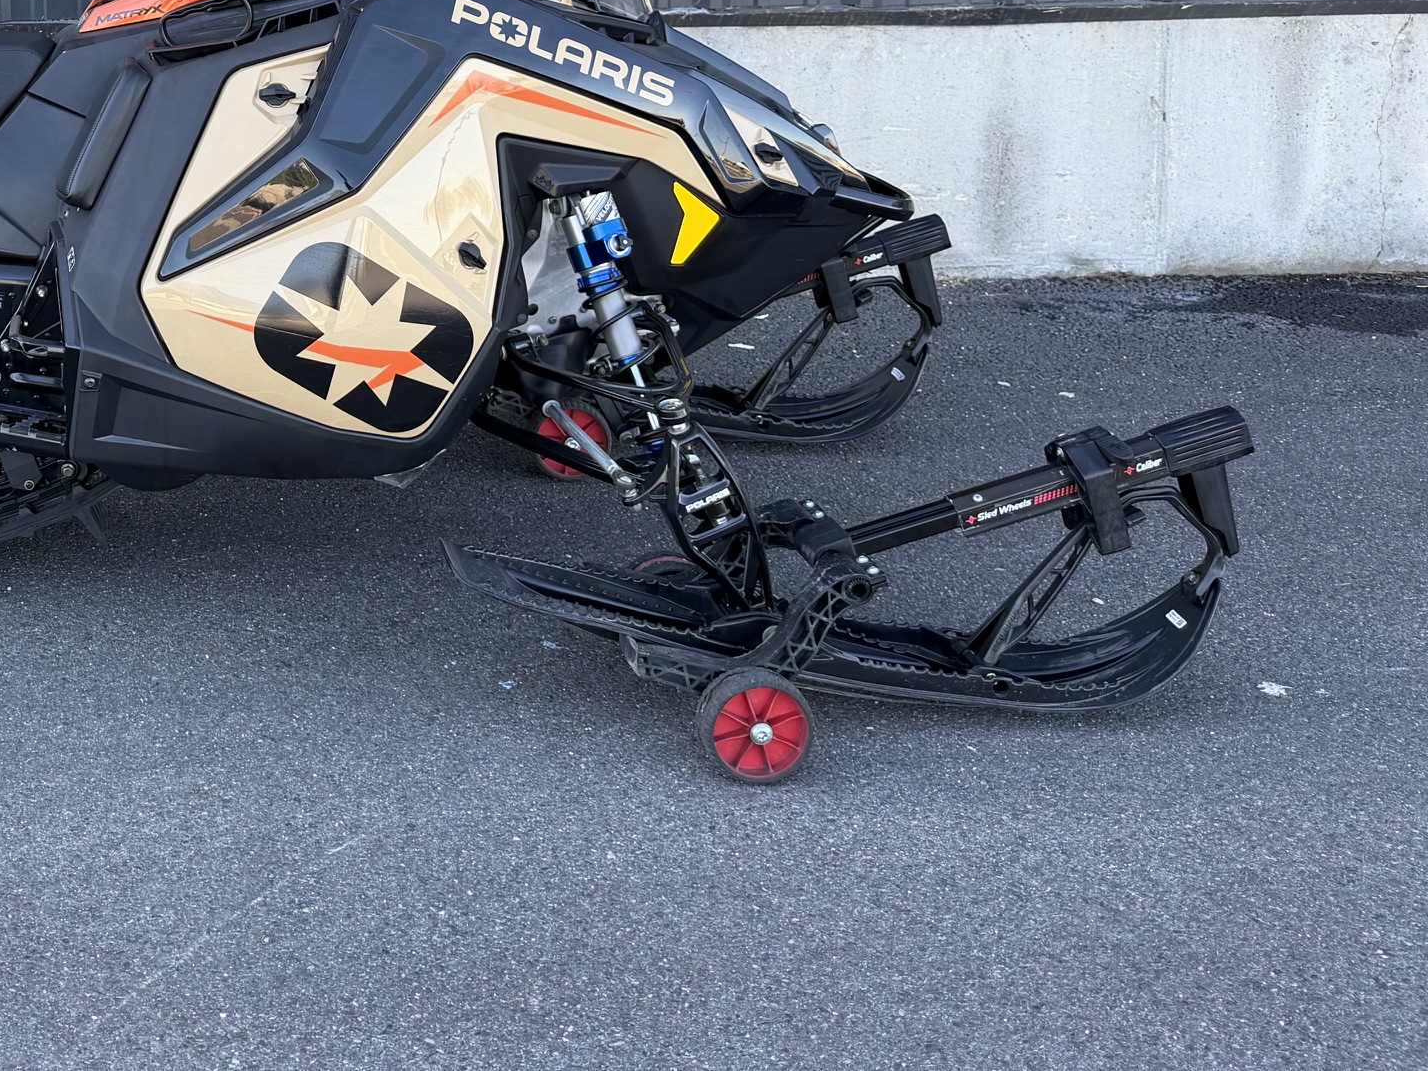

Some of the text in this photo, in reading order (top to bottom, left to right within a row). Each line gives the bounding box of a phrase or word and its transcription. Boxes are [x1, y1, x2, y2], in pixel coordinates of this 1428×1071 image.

[95, 4, 166, 26] MATRYX
[1135, 458, 1164, 473] Caliber
[685, 487, 732, 513] POLARIS
[977, 498, 1033, 522] Sled Wheels
